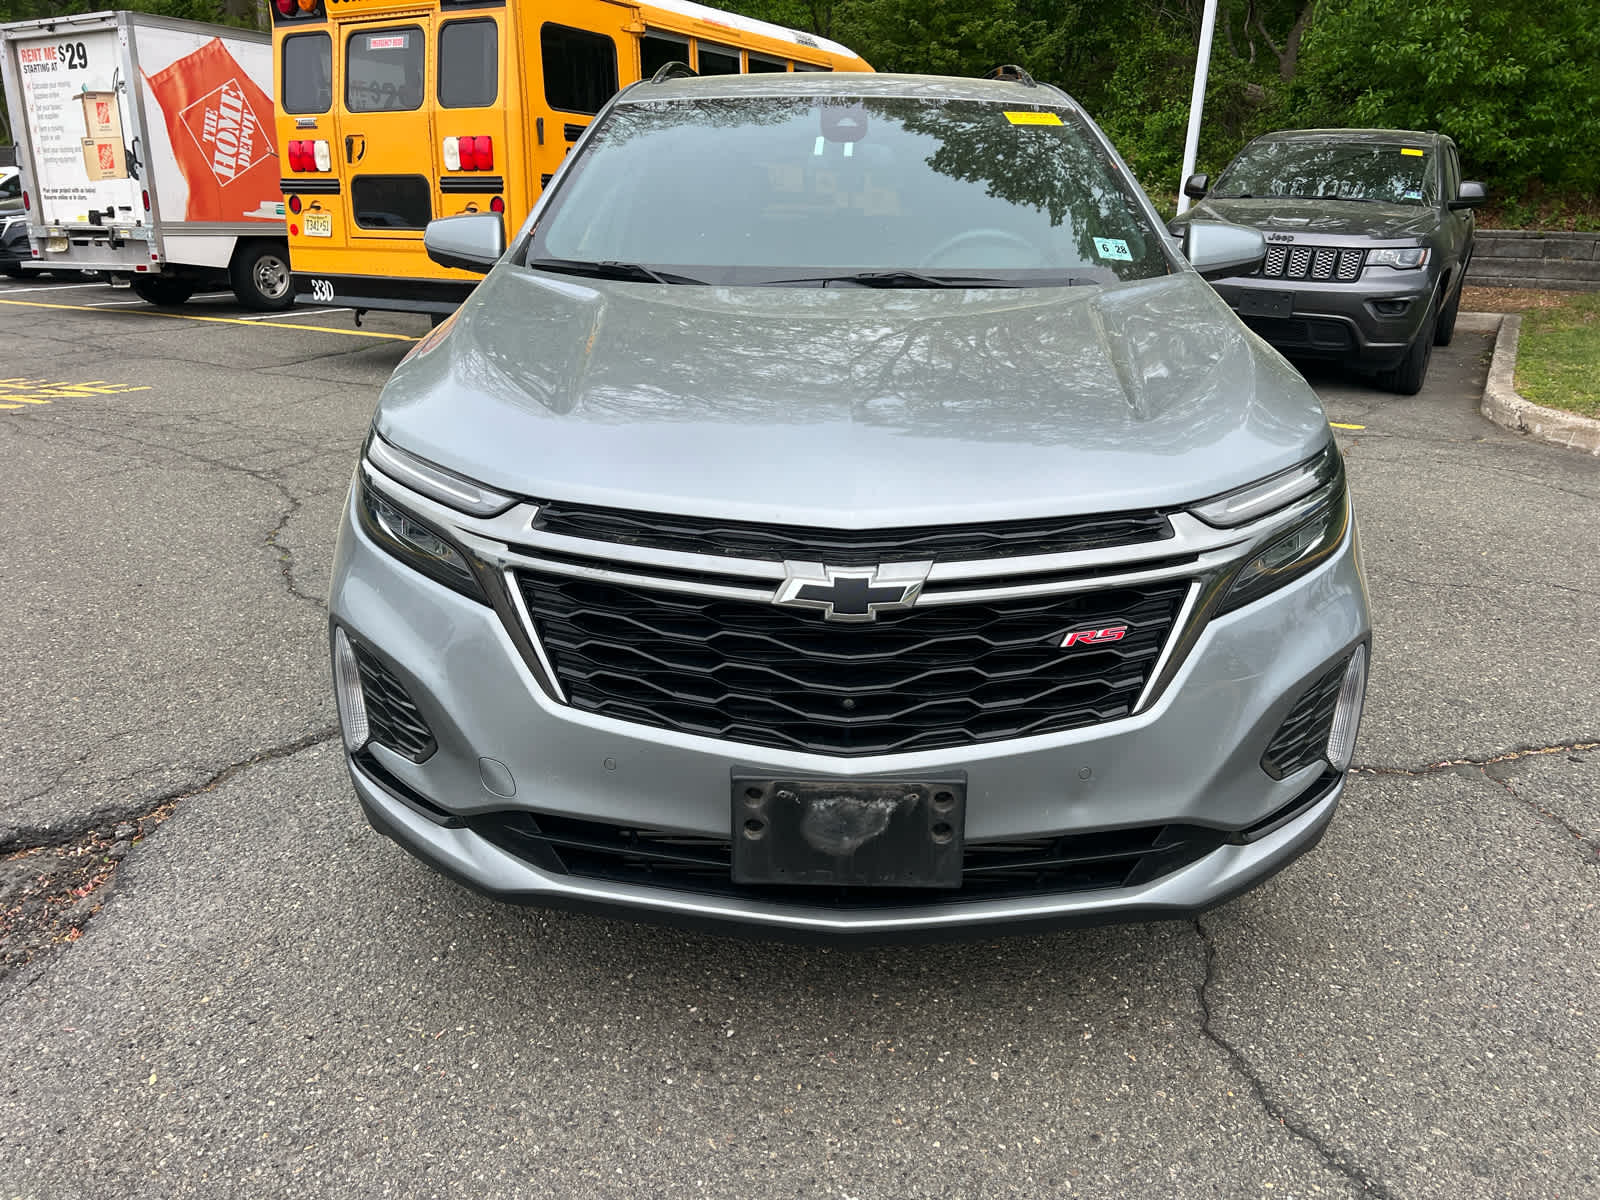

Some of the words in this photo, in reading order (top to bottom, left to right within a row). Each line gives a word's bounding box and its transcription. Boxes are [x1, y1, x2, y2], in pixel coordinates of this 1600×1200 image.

[21, 47, 42, 63] RENT
[43, 46, 57, 61] ME
[58, 42, 88, 70] $29
[23, 63, 50, 74] STARTING
[51, 62, 58, 72] AT
[202, 106, 218, 143] THE
[213, 85, 245, 179] HOME
[238, 108, 257, 168] DEPOT
[1102, 244, 1109, 253] 6
[1114, 245, 1128, 254] 28
[1267, 233, 1295, 243] Jeep
[1060, 625, 1129, 647] RS
